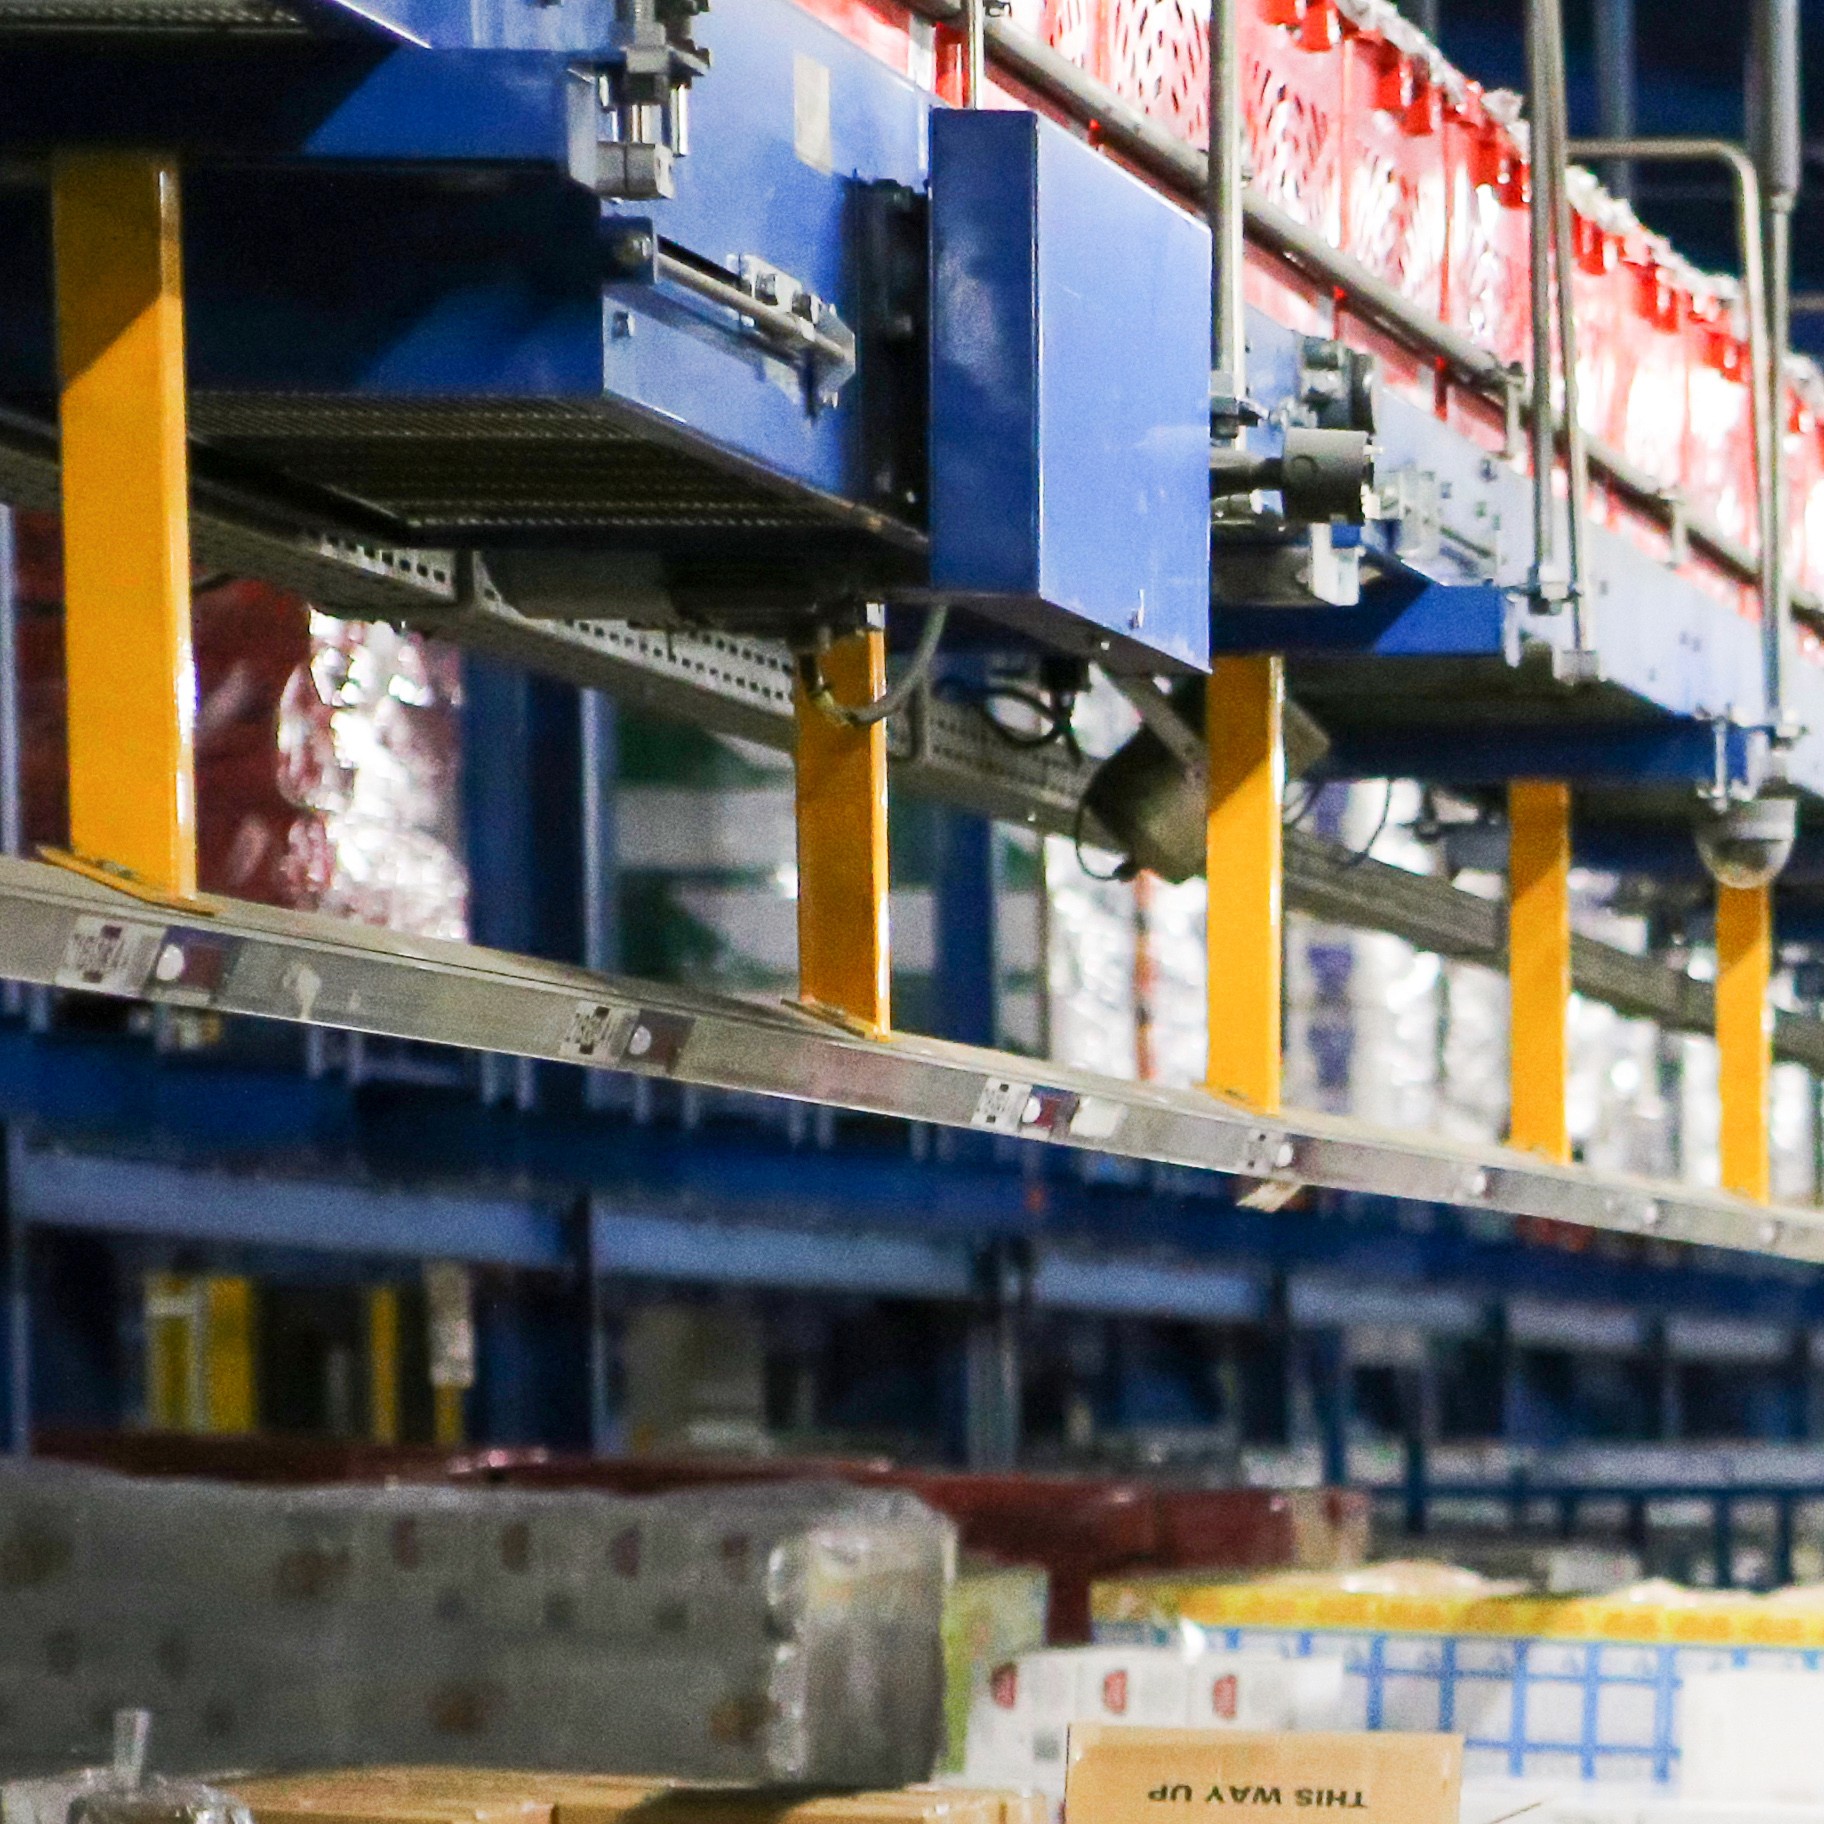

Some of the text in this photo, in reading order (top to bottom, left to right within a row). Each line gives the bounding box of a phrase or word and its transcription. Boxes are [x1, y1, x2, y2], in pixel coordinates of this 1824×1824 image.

[1148, 1784, 1368, 1808] THIS WAY UP
